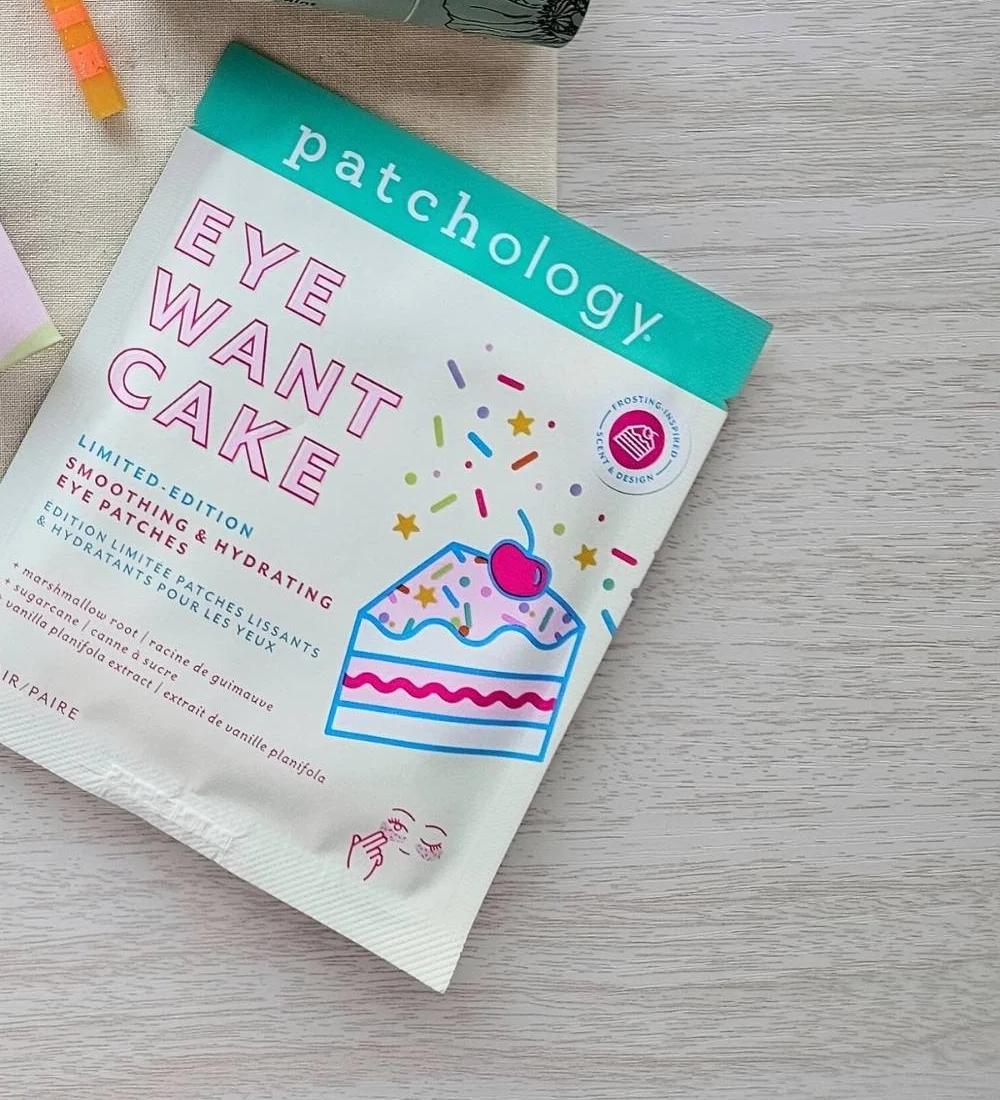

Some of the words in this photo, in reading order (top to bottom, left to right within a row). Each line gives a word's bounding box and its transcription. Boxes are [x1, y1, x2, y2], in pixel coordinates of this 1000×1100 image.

[180, 200, 342, 325] EYE
[282, 125, 663, 359] patchology
[157, 268, 401, 438] WANT
[77, 434, 254, 539] LIMITED-EDITION
[109, 360, 338, 505] CAKE
[596, 431, 609, 465] SCENT
[616, 473, 654, 484] DESIGN
[57, 474, 94, 504] EYE
[99, 498, 188, 555] PATCHES
[65, 456, 188, 532] SMOOTHING
[194, 528, 207, 545] &
[213, 538, 332, 610] HYDRATING
[12, 585, 80, 628] sugarcane
[90, 628, 128, 654] canne
[131, 649, 141, 661] à
[142, 658, 180, 683] sucre
[21, 568, 107, 620] marshmallow
[109, 618, 138, 638] root
[148, 640, 192, 667] racine
[192, 663, 209, 677] de
[208, 674, 274, 715] guimauve
[37, 515, 47, 528] &
[51, 524, 152, 586] HYDRATANTS
[157, 582, 200, 613] POUR
[204, 608, 230, 628] LES
[237, 624, 276, 653] YEUX
[176, 575, 245, 618] PATCHES
[248, 613, 320, 659] LISSANTS
[6, 600, 48, 629] vanilla
[48, 626, 108, 664] planifola
[107, 660, 152, 689] extract
[163, 691, 207, 719] extrait
[208, 712, 224, 727] de
[224, 724, 268, 753] vanille
[267, 748, 327, 784] planifola
